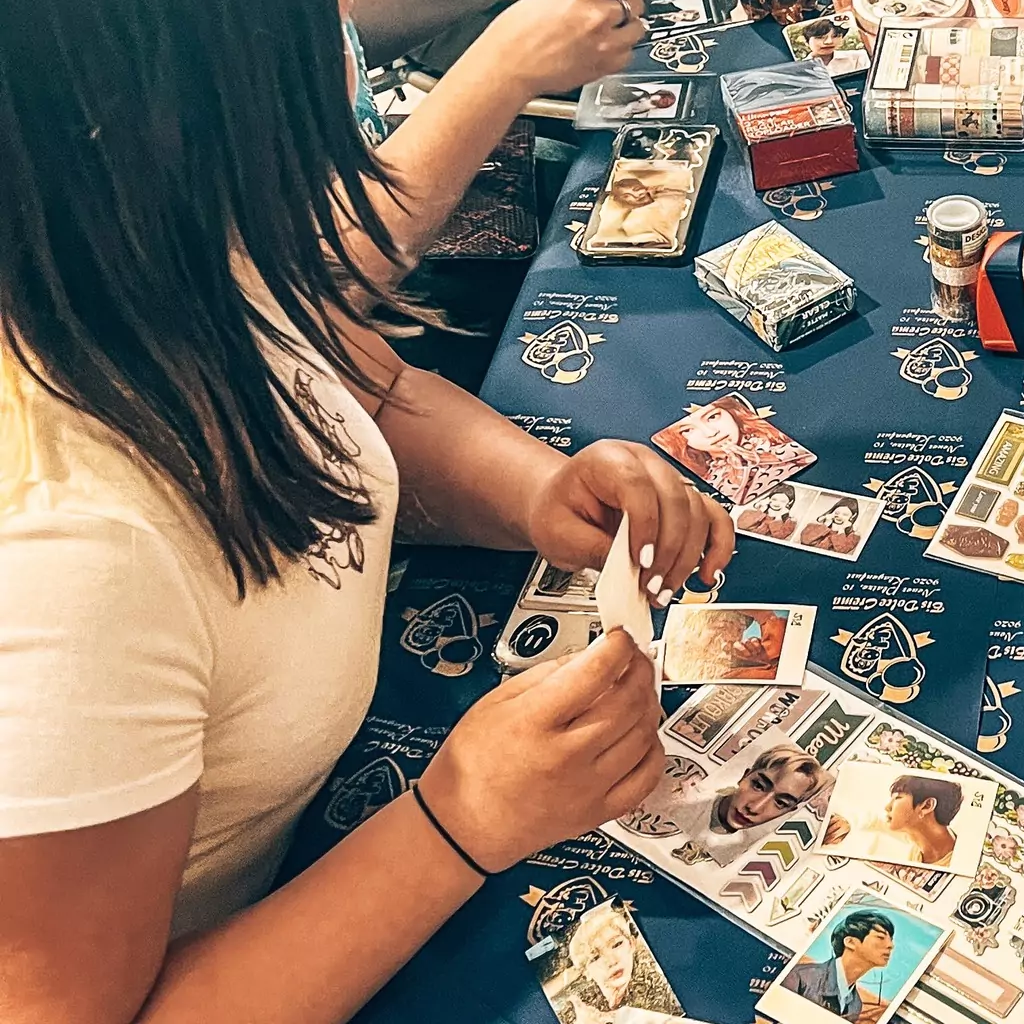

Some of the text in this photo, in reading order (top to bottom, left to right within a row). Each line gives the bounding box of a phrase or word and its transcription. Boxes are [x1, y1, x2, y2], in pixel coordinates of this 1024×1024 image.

[523, 309, 562, 320] Crema
[563, 311, 597, 321] Dolce
[801, 300, 830, 320] CLEAR
[807, 311, 828, 326] MATTE
[891, 326, 965, 338] Dolce Crema
[686, 378, 786, 392] Eis Dolce Crema
[548, 436, 572, 446] Eis
[938, 434, 963, 443] 9020
[864, 452, 968, 466] Eis Dolce Crema
[988, 440, 1013, 475] AMAZING
[846, 572, 940, 586] 9020 Klagenfurt
[842, 584, 855, 592] 10
[902, 586, 941, 598] Neuer
[832, 596, 945, 613] Eis Dolce Crema
[994, 620, 1022, 628] 9020
[989, 631, 1024, 642] Neue
[804, 717, 850, 756] Mee
[382, 741, 424, 758] Dolce
[580, 862, 625, 879] Dolce
[628, 868, 654, 884] Eis
